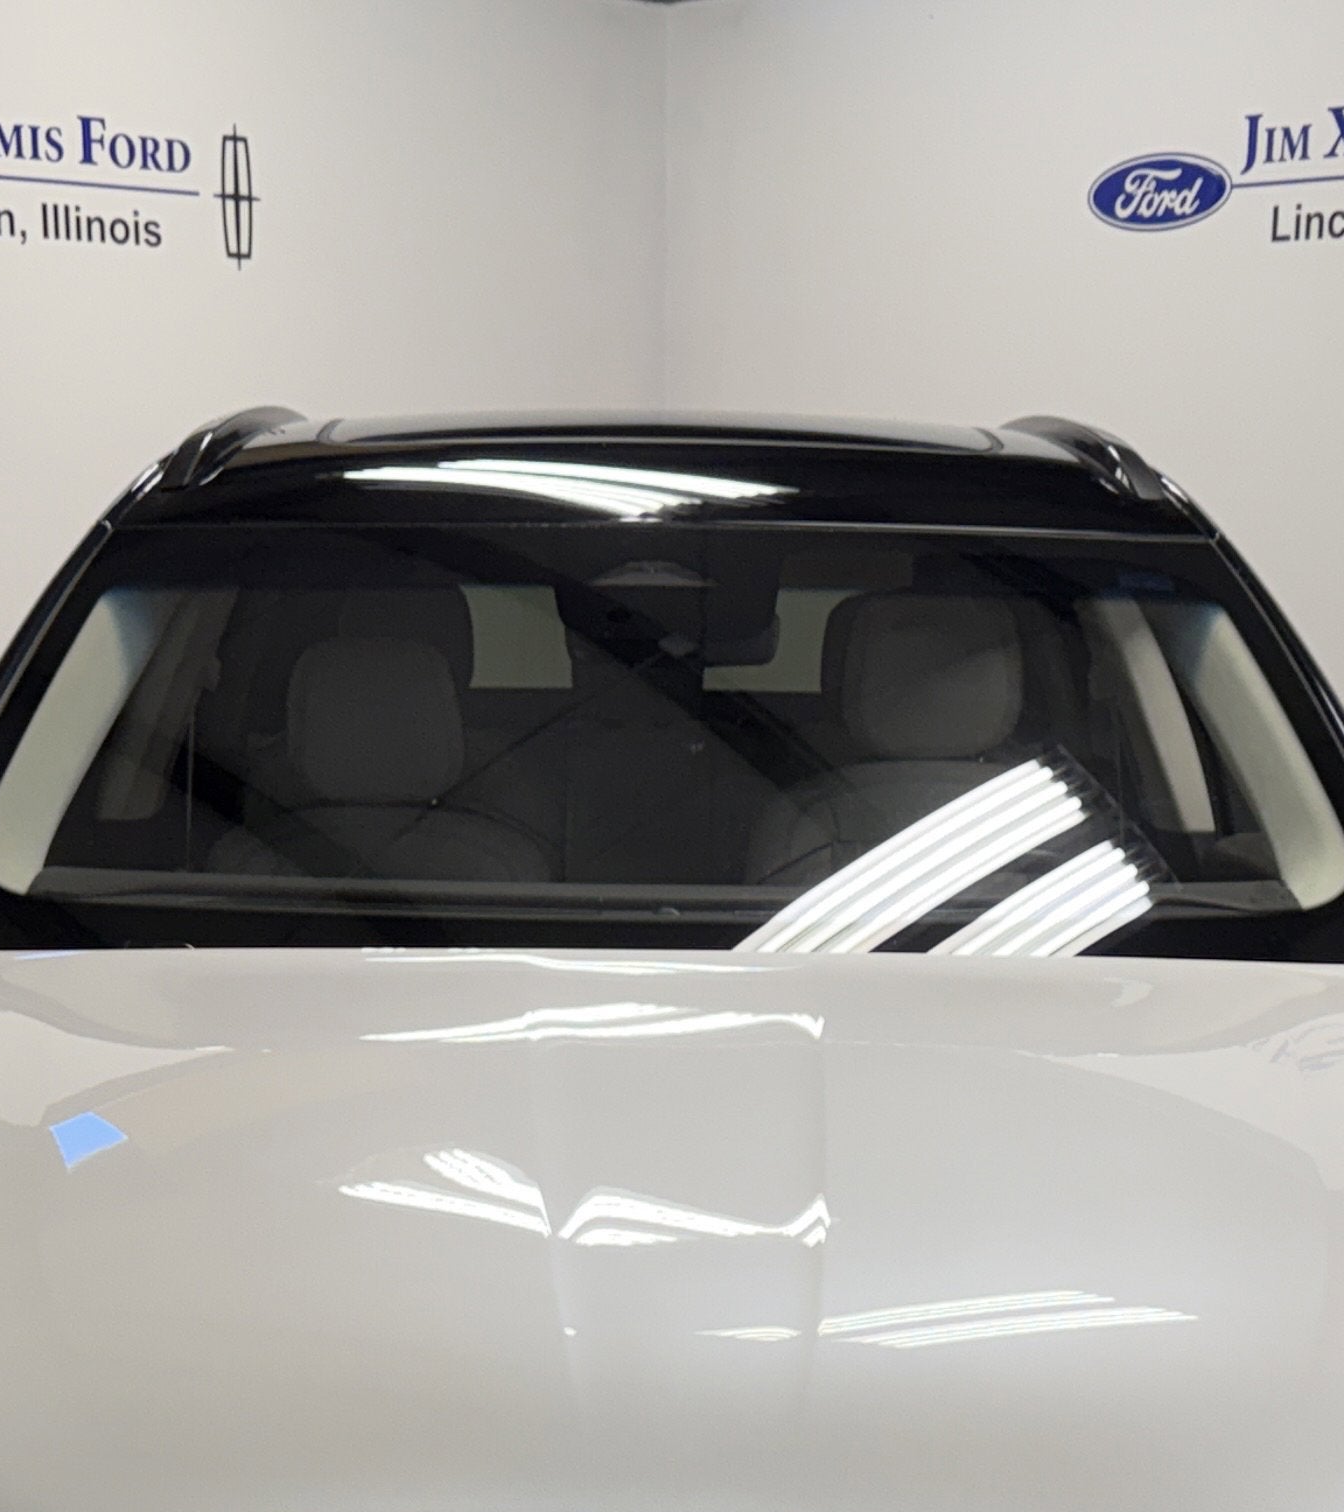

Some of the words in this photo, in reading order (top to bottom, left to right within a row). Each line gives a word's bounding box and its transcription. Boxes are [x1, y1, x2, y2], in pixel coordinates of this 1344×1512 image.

[77, 115, 192, 174] FORD
[1240, 113, 1312, 175] JIM
[1115, 168, 1201, 220] Ford
[41, 203, 162, 248] Illinois
